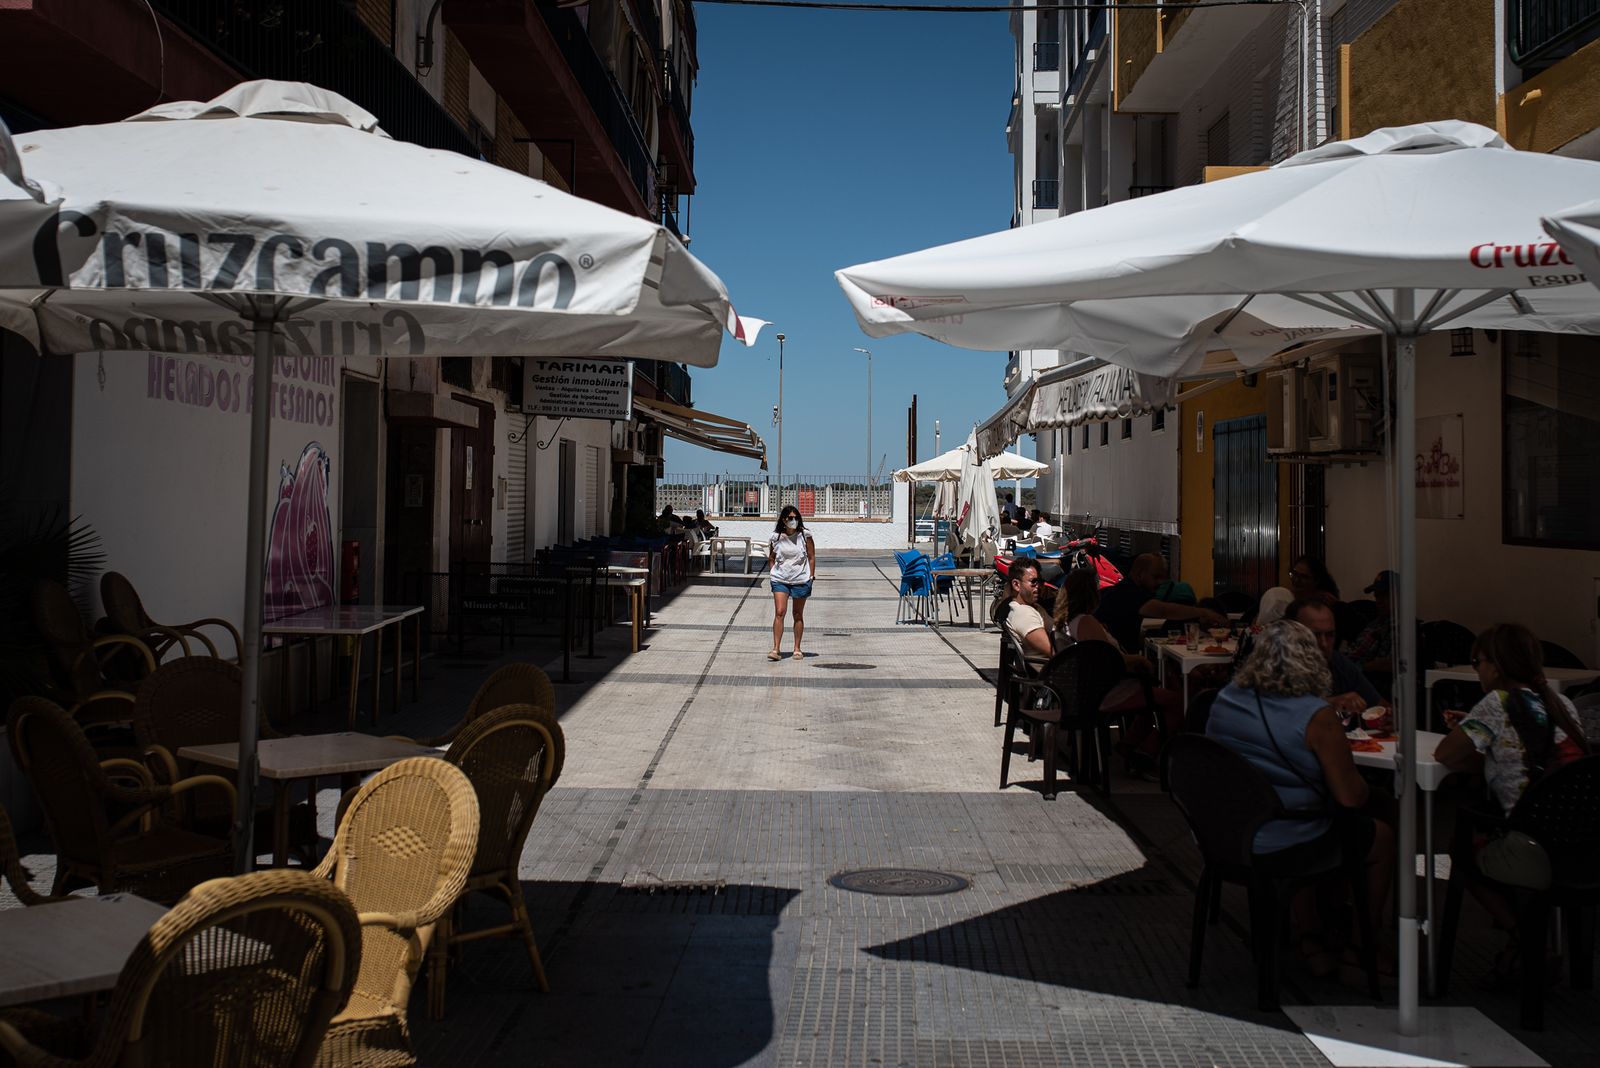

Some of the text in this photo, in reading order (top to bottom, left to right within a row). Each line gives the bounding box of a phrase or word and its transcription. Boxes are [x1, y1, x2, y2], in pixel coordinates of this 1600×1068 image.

[536, 361, 626, 375] TARIMAR
[532, 374, 629, 388] Gestión inmobiliaria
[246, 374, 334, 427] ATESANOS
